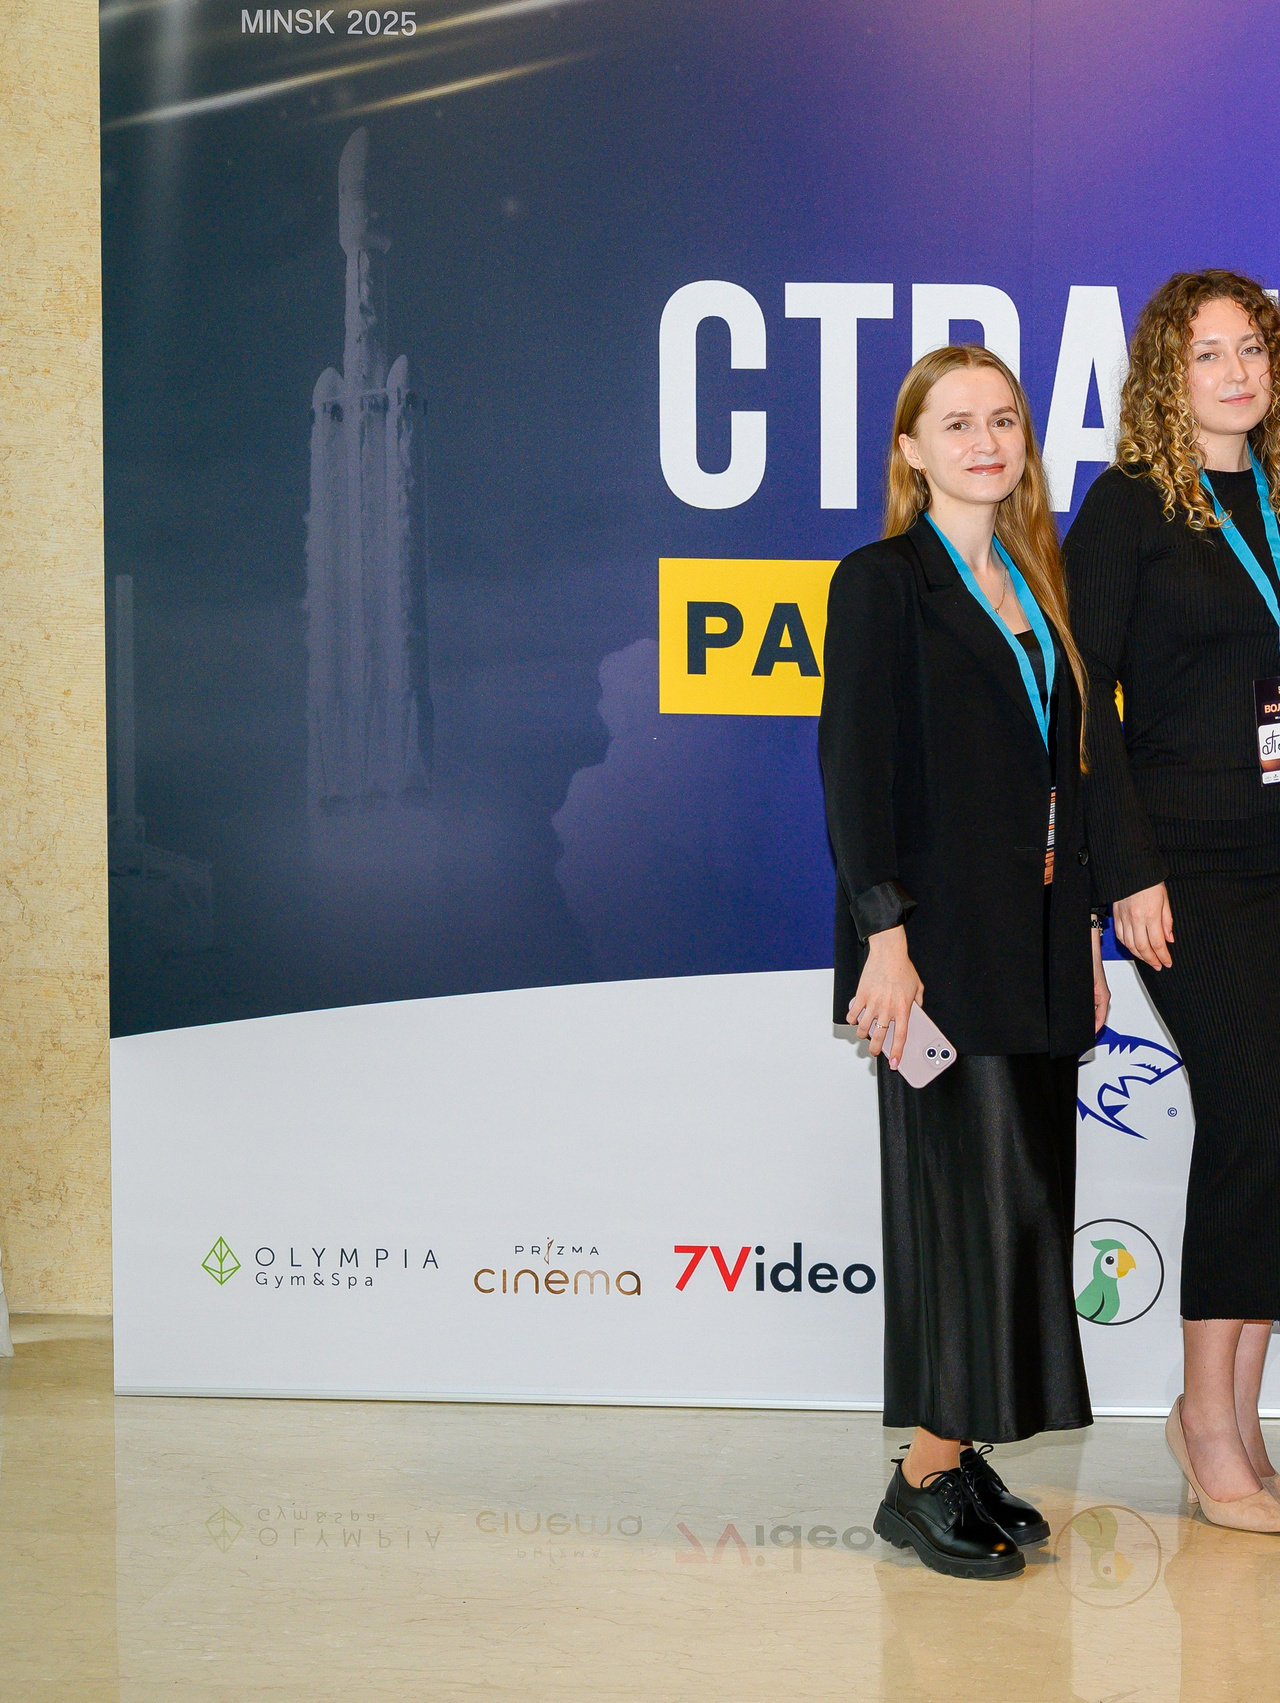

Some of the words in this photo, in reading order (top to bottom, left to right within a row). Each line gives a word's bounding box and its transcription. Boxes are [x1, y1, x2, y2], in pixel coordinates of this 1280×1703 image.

[241, 9, 335, 34] MINSK
[347, 10, 417, 36] 2025
[255, 1247, 439, 1269] OLYMPIA
[514, 1237, 600, 1265] PRIZMA
[255, 1271, 373, 1289] Gym&Spa
[474, 1268, 642, 1296] cinema
[674, 1242, 876, 1295] 7Video
